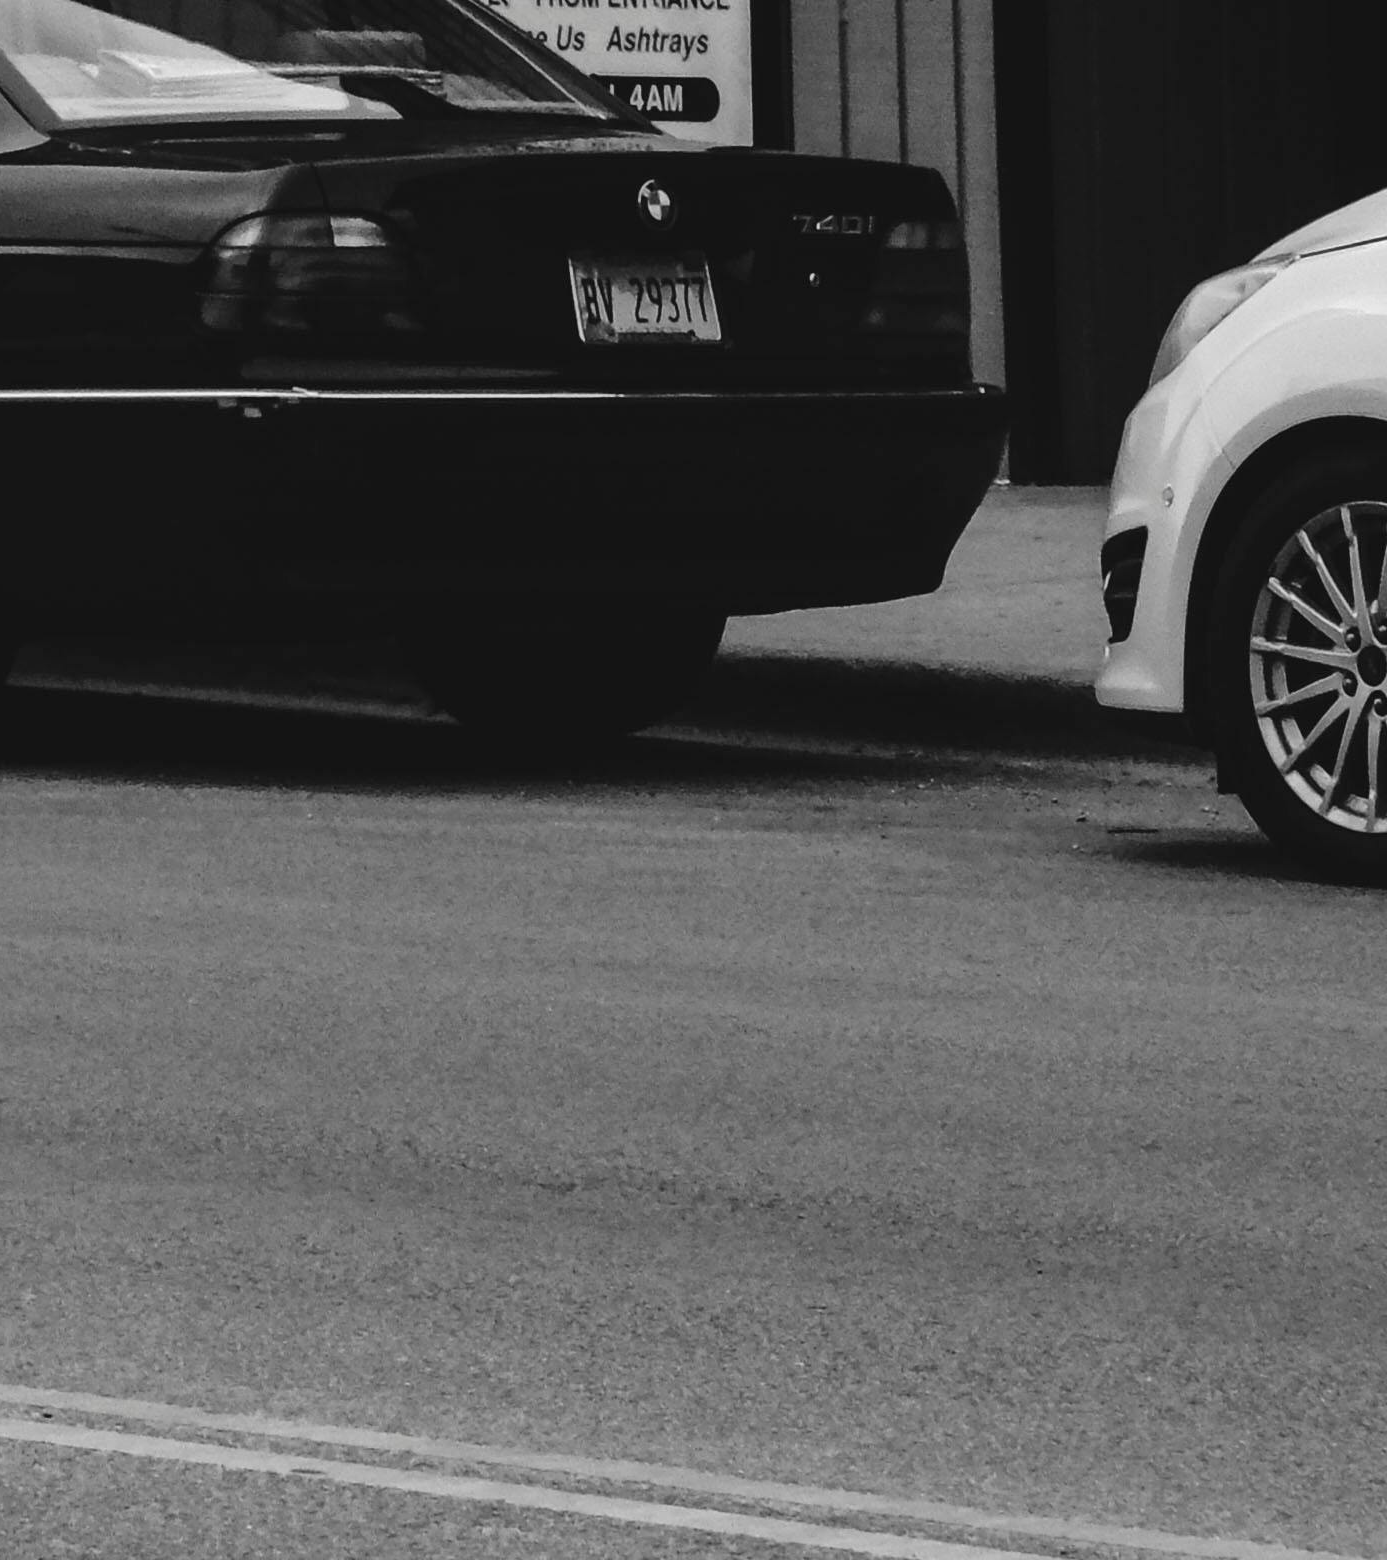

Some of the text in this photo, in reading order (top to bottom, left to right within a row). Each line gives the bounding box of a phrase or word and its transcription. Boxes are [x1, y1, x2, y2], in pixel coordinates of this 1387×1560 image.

[606, 25, 709, 62] Ashtrays
[629, 84, 683, 112] 4AM
[629, 277, 708, 324] 29377
